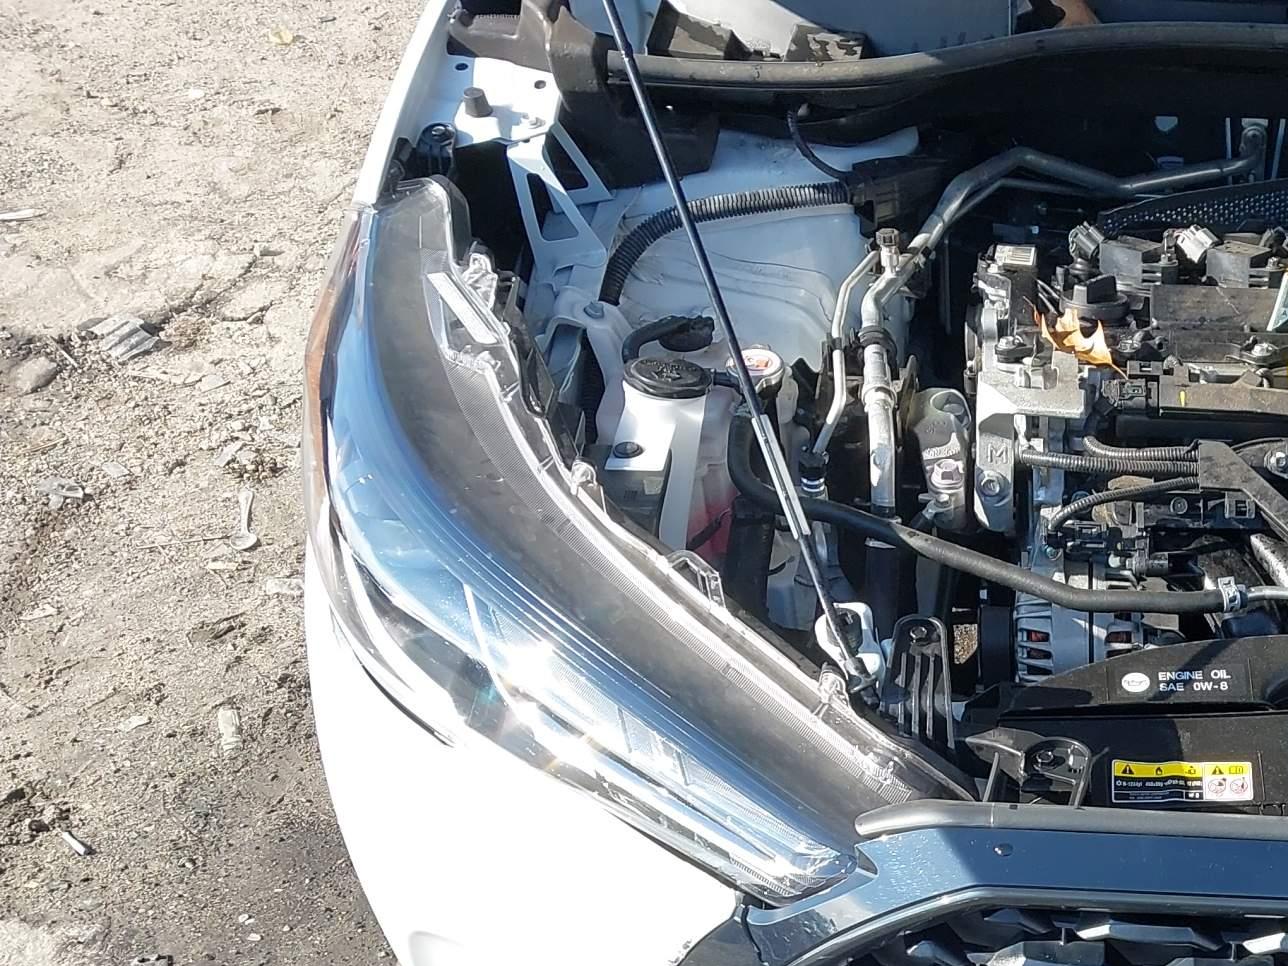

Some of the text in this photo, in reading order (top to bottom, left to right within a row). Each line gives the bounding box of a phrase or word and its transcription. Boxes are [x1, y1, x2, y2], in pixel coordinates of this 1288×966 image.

[1158, 669, 1231, 681] ENGINE OIL
[1159, 682, 1229, 692] SAE 0W-8
